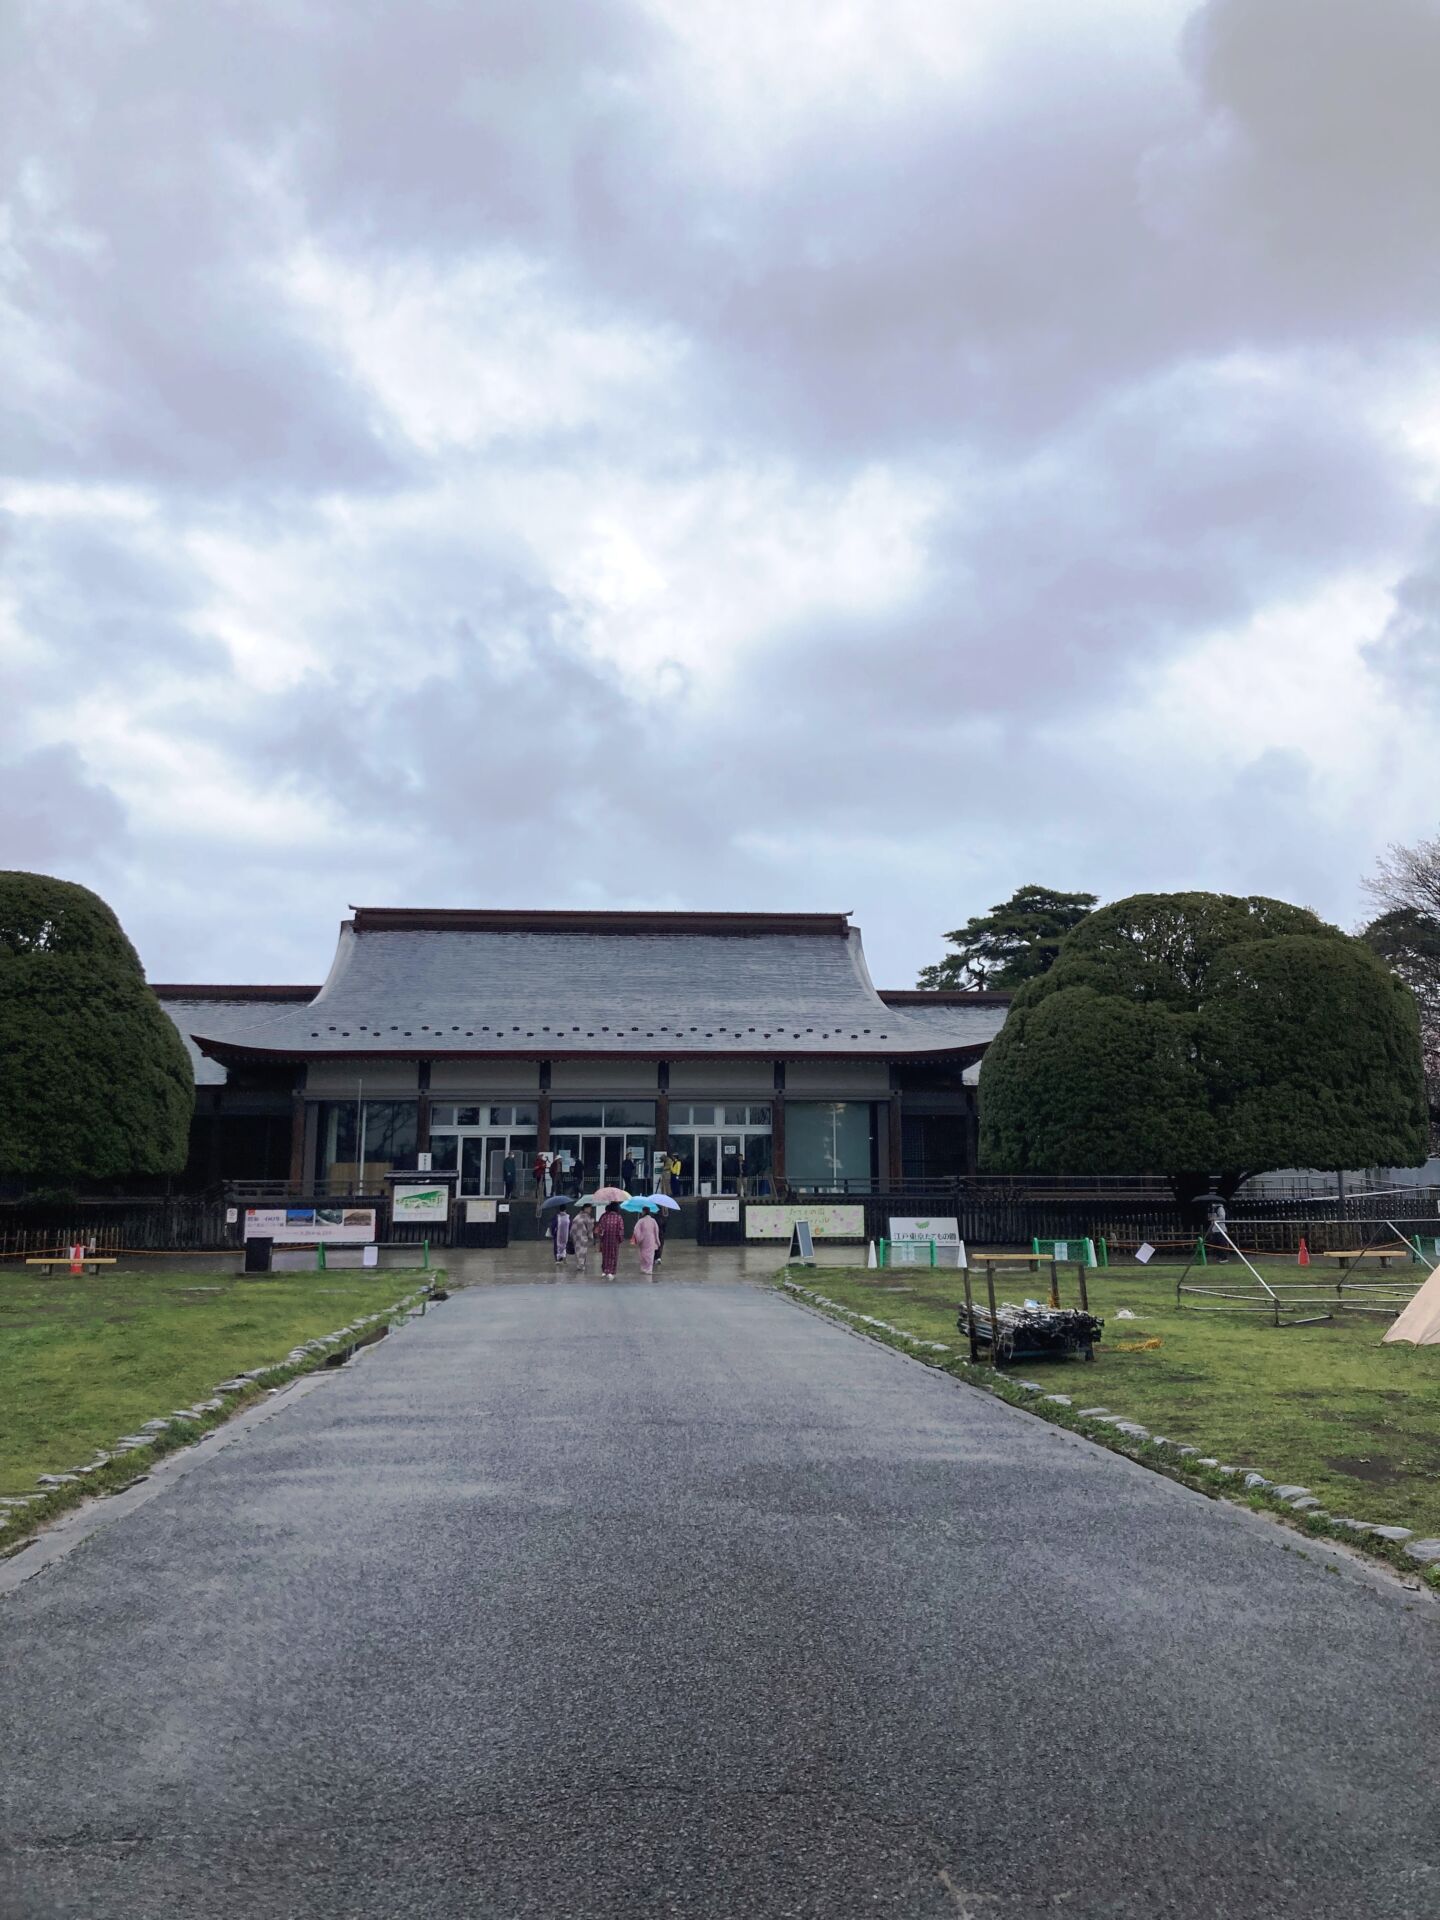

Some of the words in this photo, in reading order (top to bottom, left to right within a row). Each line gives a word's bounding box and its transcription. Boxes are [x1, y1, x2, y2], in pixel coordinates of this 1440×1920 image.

[893, 1231, 957, 1241] 江戸東京たてもの園
